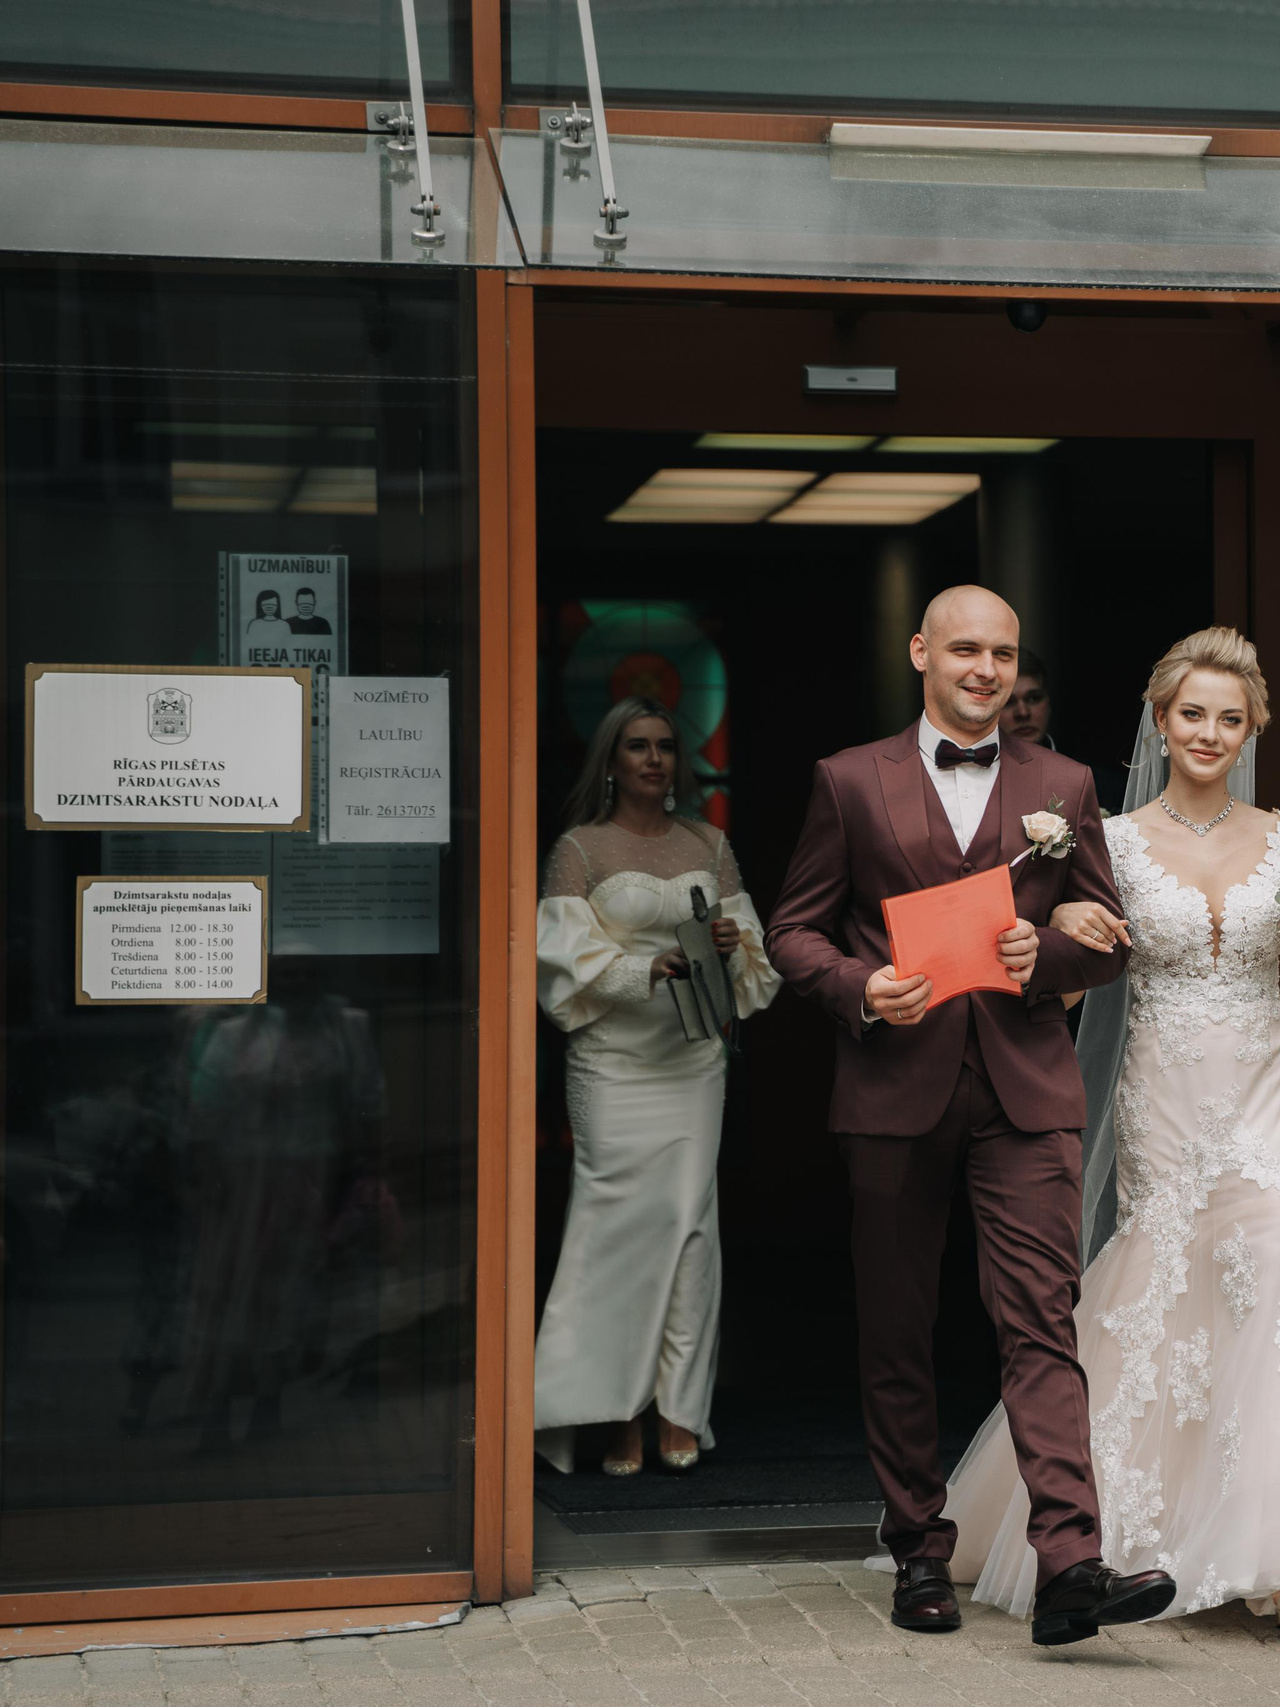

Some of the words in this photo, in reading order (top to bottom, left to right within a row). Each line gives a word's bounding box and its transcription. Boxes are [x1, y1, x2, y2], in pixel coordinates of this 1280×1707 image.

[248, 557, 331, 573] UZMANĪBU!
[249, 648, 288, 662] IEEJA
[293, 648, 331, 662] TIKAI
[354, 691, 429, 703] NOZĪMĒTO
[360, 728, 423, 740] LAULĪBU
[113, 758, 157, 771] RĪGAS
[161, 759, 226, 771] PILSĒTAS
[340, 766, 442, 780] REĢISTRĀCIJA
[118, 775, 220, 788] PĀRDAUGAVAS
[57, 794, 204, 807] DZIMTSARAKSTU
[209, 796, 279, 810] NODAĻA
[346, 805, 372, 816] Tālr.
[377, 806, 436, 818] 26137075
[114, 891, 189, 899] Dzimtsarakstu
[192, 891, 232, 901] nodaļas
[93, 904, 157, 914] apmeklētāju
[161, 904, 226, 914] pieņemšanas
[229, 904, 252, 912] laiki
[111, 924, 161, 933] Pirmdiena
[170, 923, 196, 933] 12.00
[207, 923, 233, 932] 18.30
[111, 938, 154, 947] Otrdiena
[176, 938, 196, 947] 8.00
[207, 938, 233, 946] 15.00
[111, 952, 159, 961] Trešdiena
[175, 952, 196, 961] 8.00
[207, 952, 233, 961] 15.00
[111, 966, 167, 975] Ceturtdiena
[175, 966, 196, 975] 8.00
[207, 966, 233, 975] 15.00
[111, 980, 162, 989] Piektdiena
[175, 980, 196, 989] 8.00
[207, 980, 233, 989] 14.00
